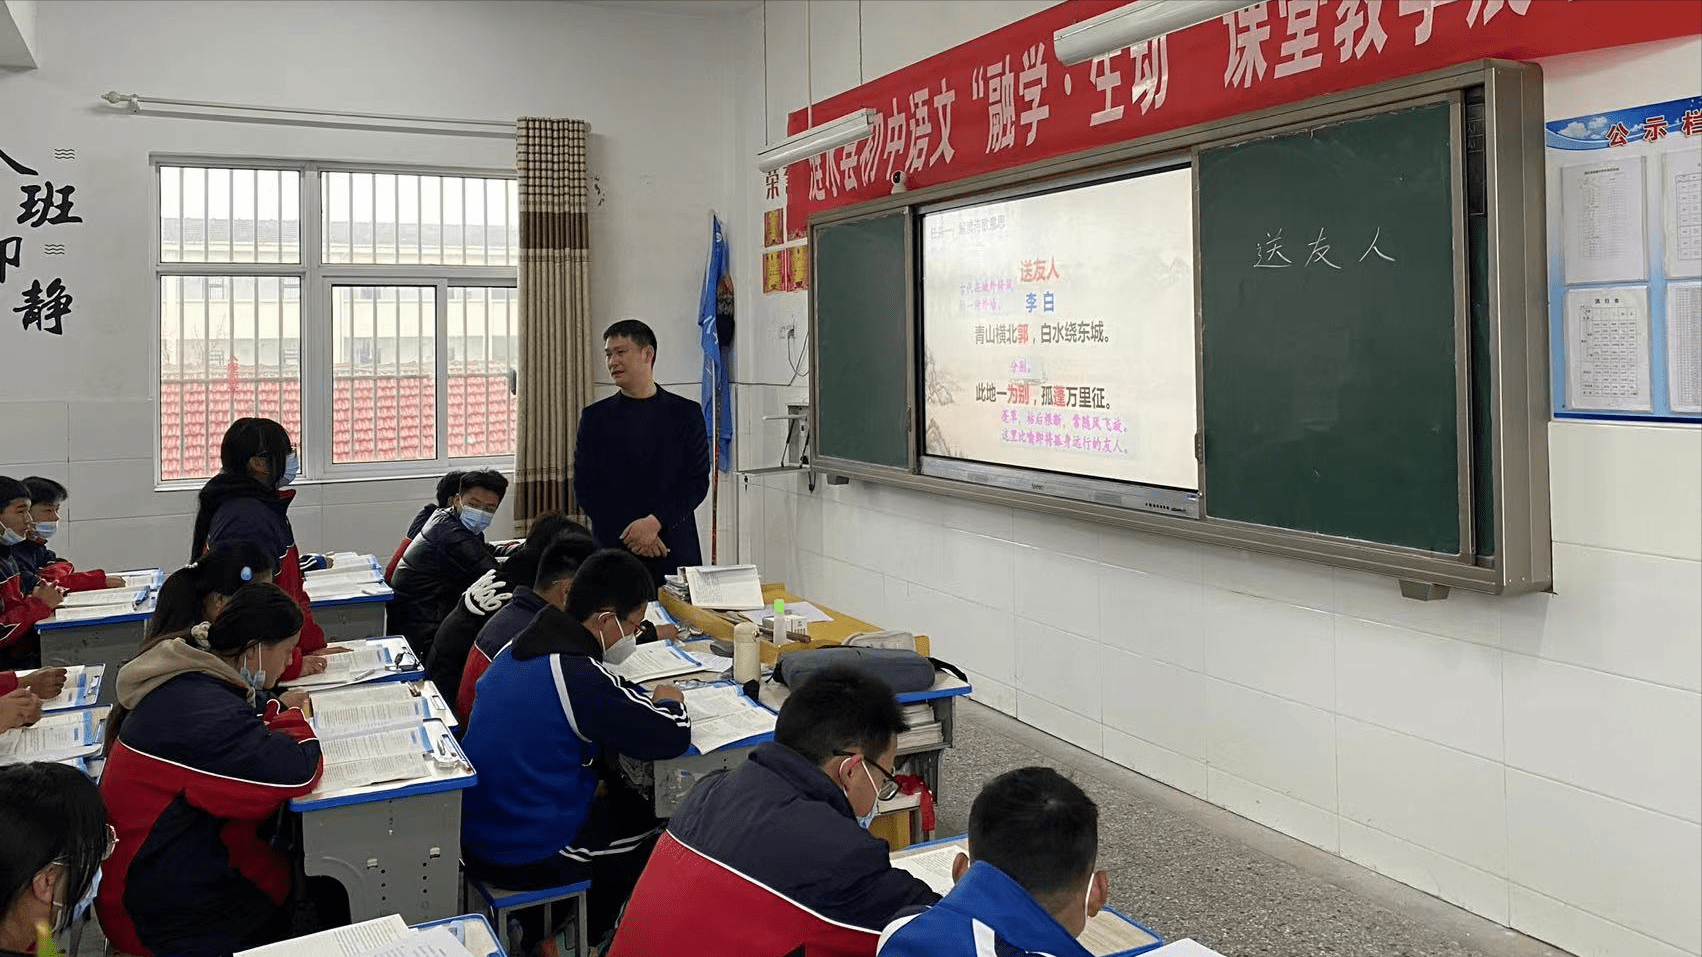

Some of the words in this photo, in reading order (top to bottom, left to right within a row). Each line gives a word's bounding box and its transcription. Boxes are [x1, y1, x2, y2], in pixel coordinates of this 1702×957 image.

[1605, 109, 1702, 148] 公示栏
[1253, 226, 1396, 270] 送友人
[1020, 256, 1060, 283] 送友人
[974, 320, 1110, 345] 青山横北郭，白水绕东城。
[975, 382, 1111, 410] 此地一为别，孤蓬万里征。
